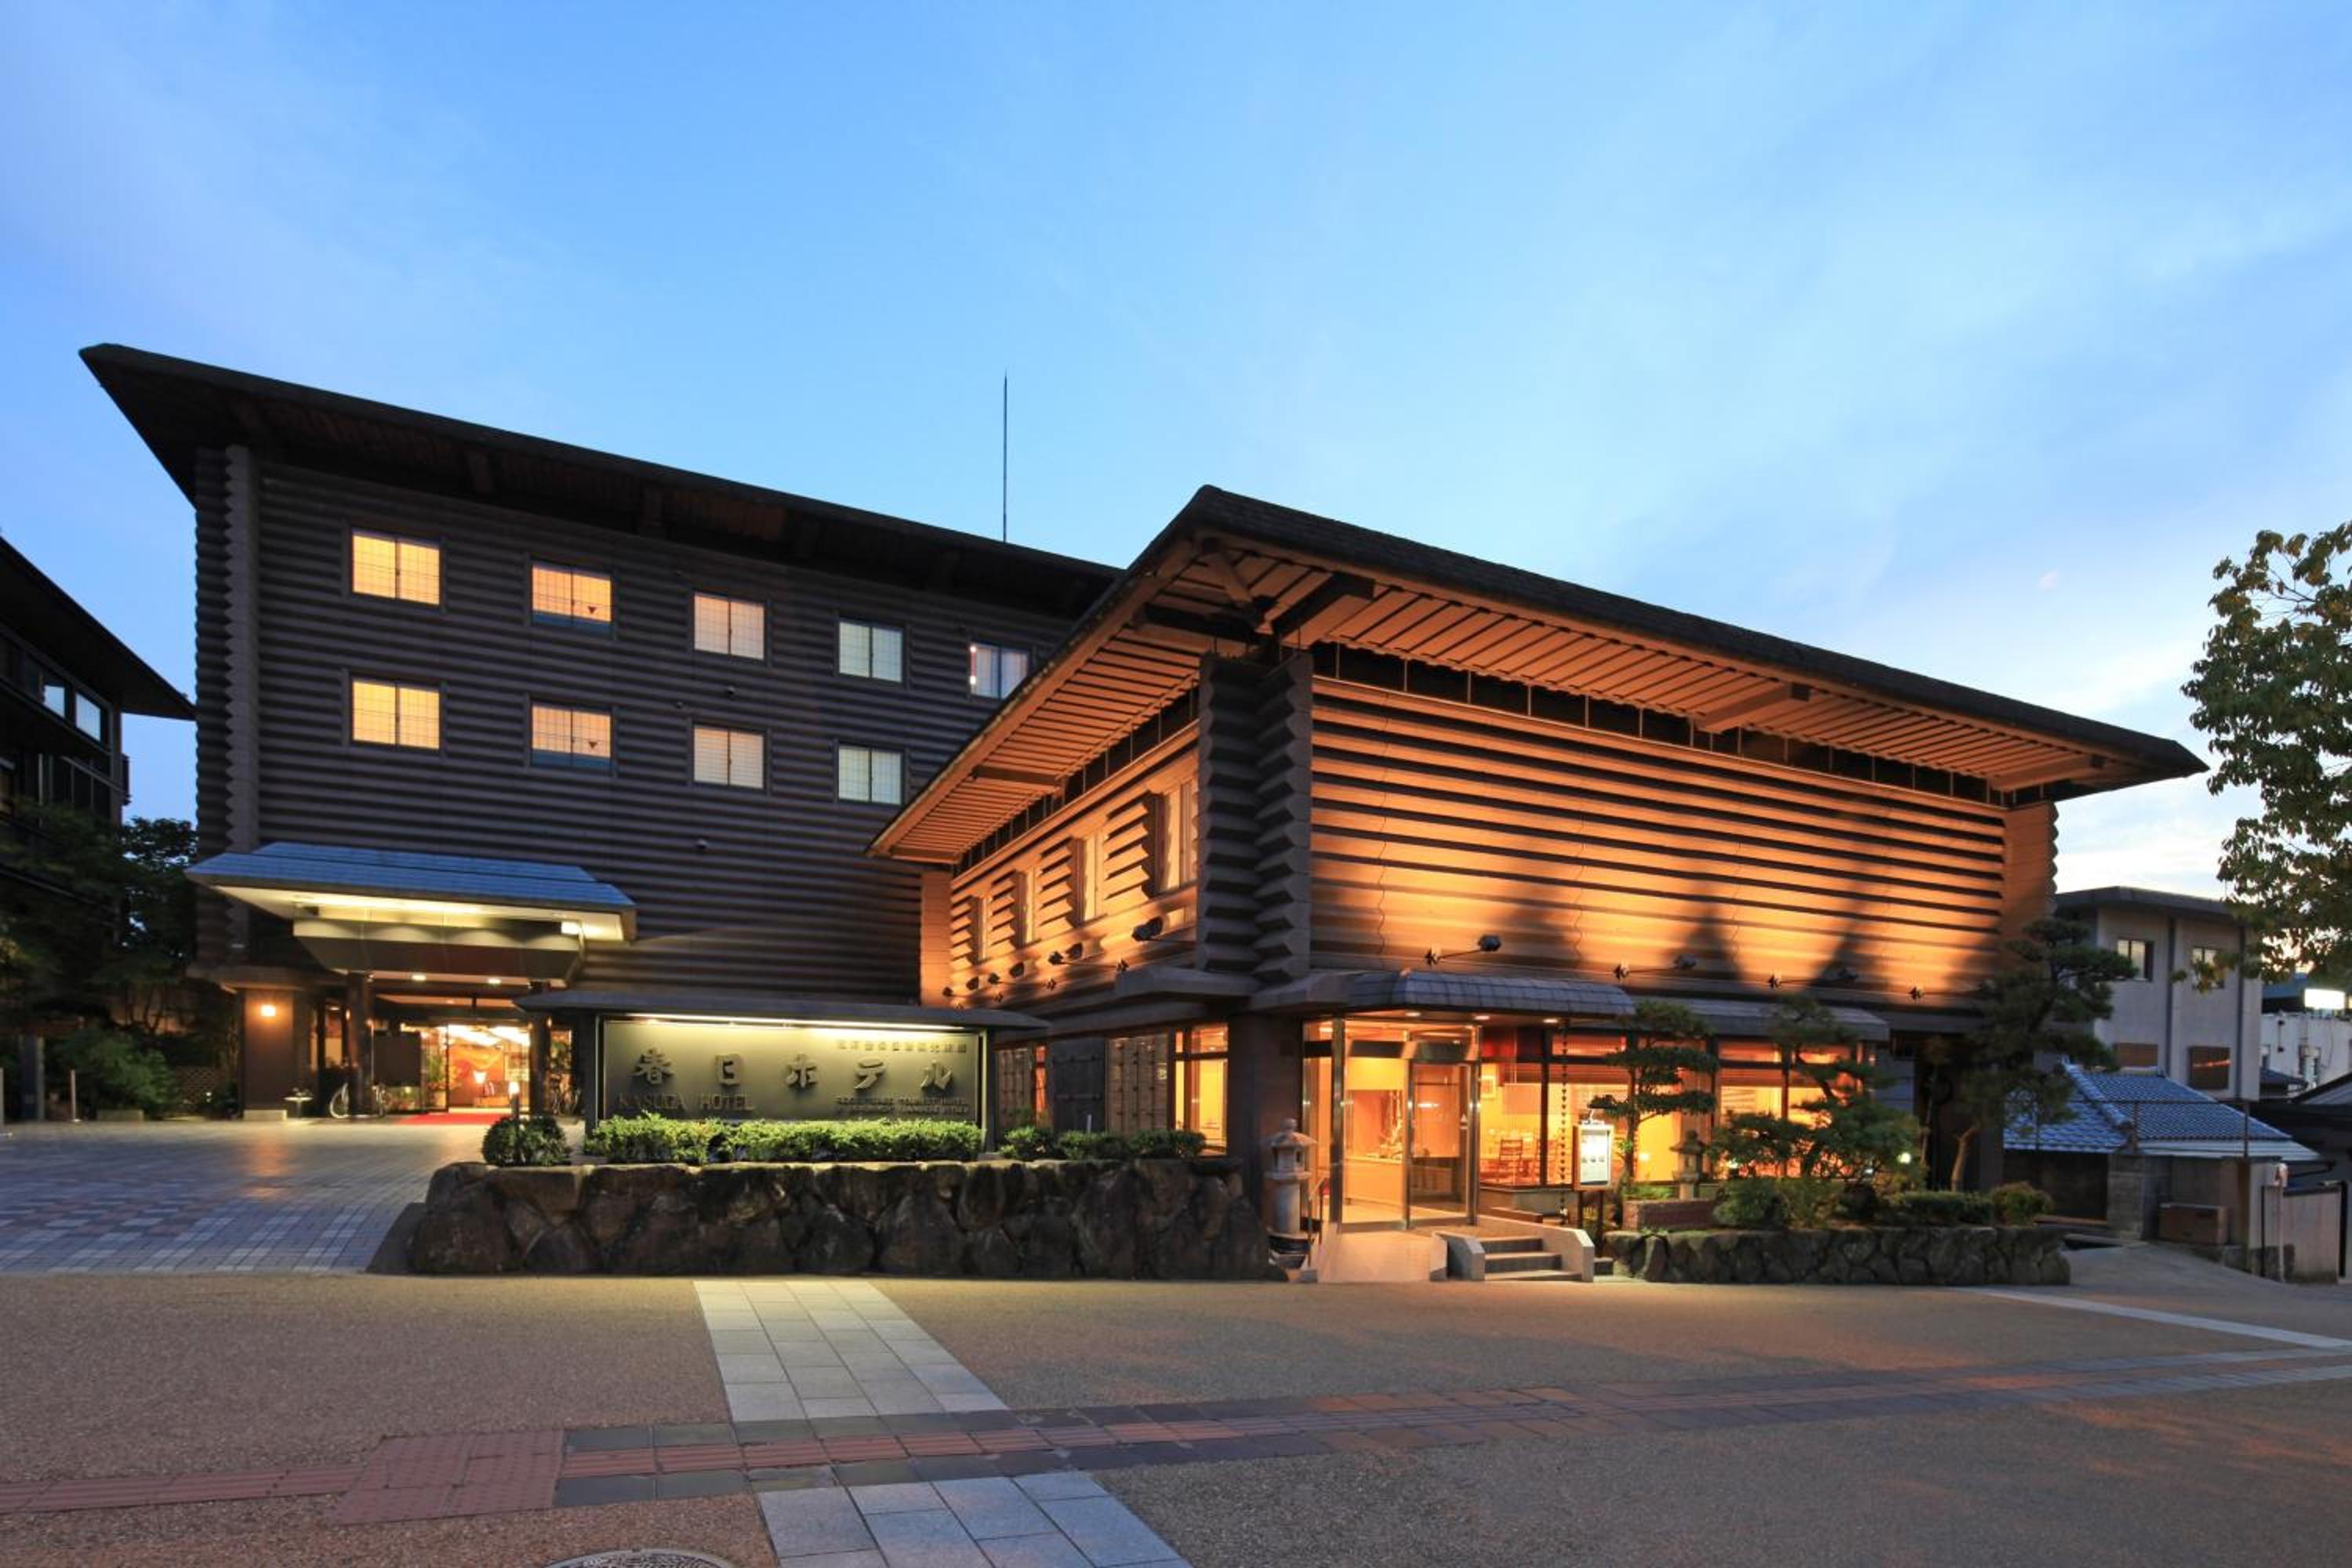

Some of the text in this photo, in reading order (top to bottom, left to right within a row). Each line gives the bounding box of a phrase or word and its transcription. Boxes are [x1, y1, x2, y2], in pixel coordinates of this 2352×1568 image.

[633, 1047, 953, 1091] 春日ホテル
